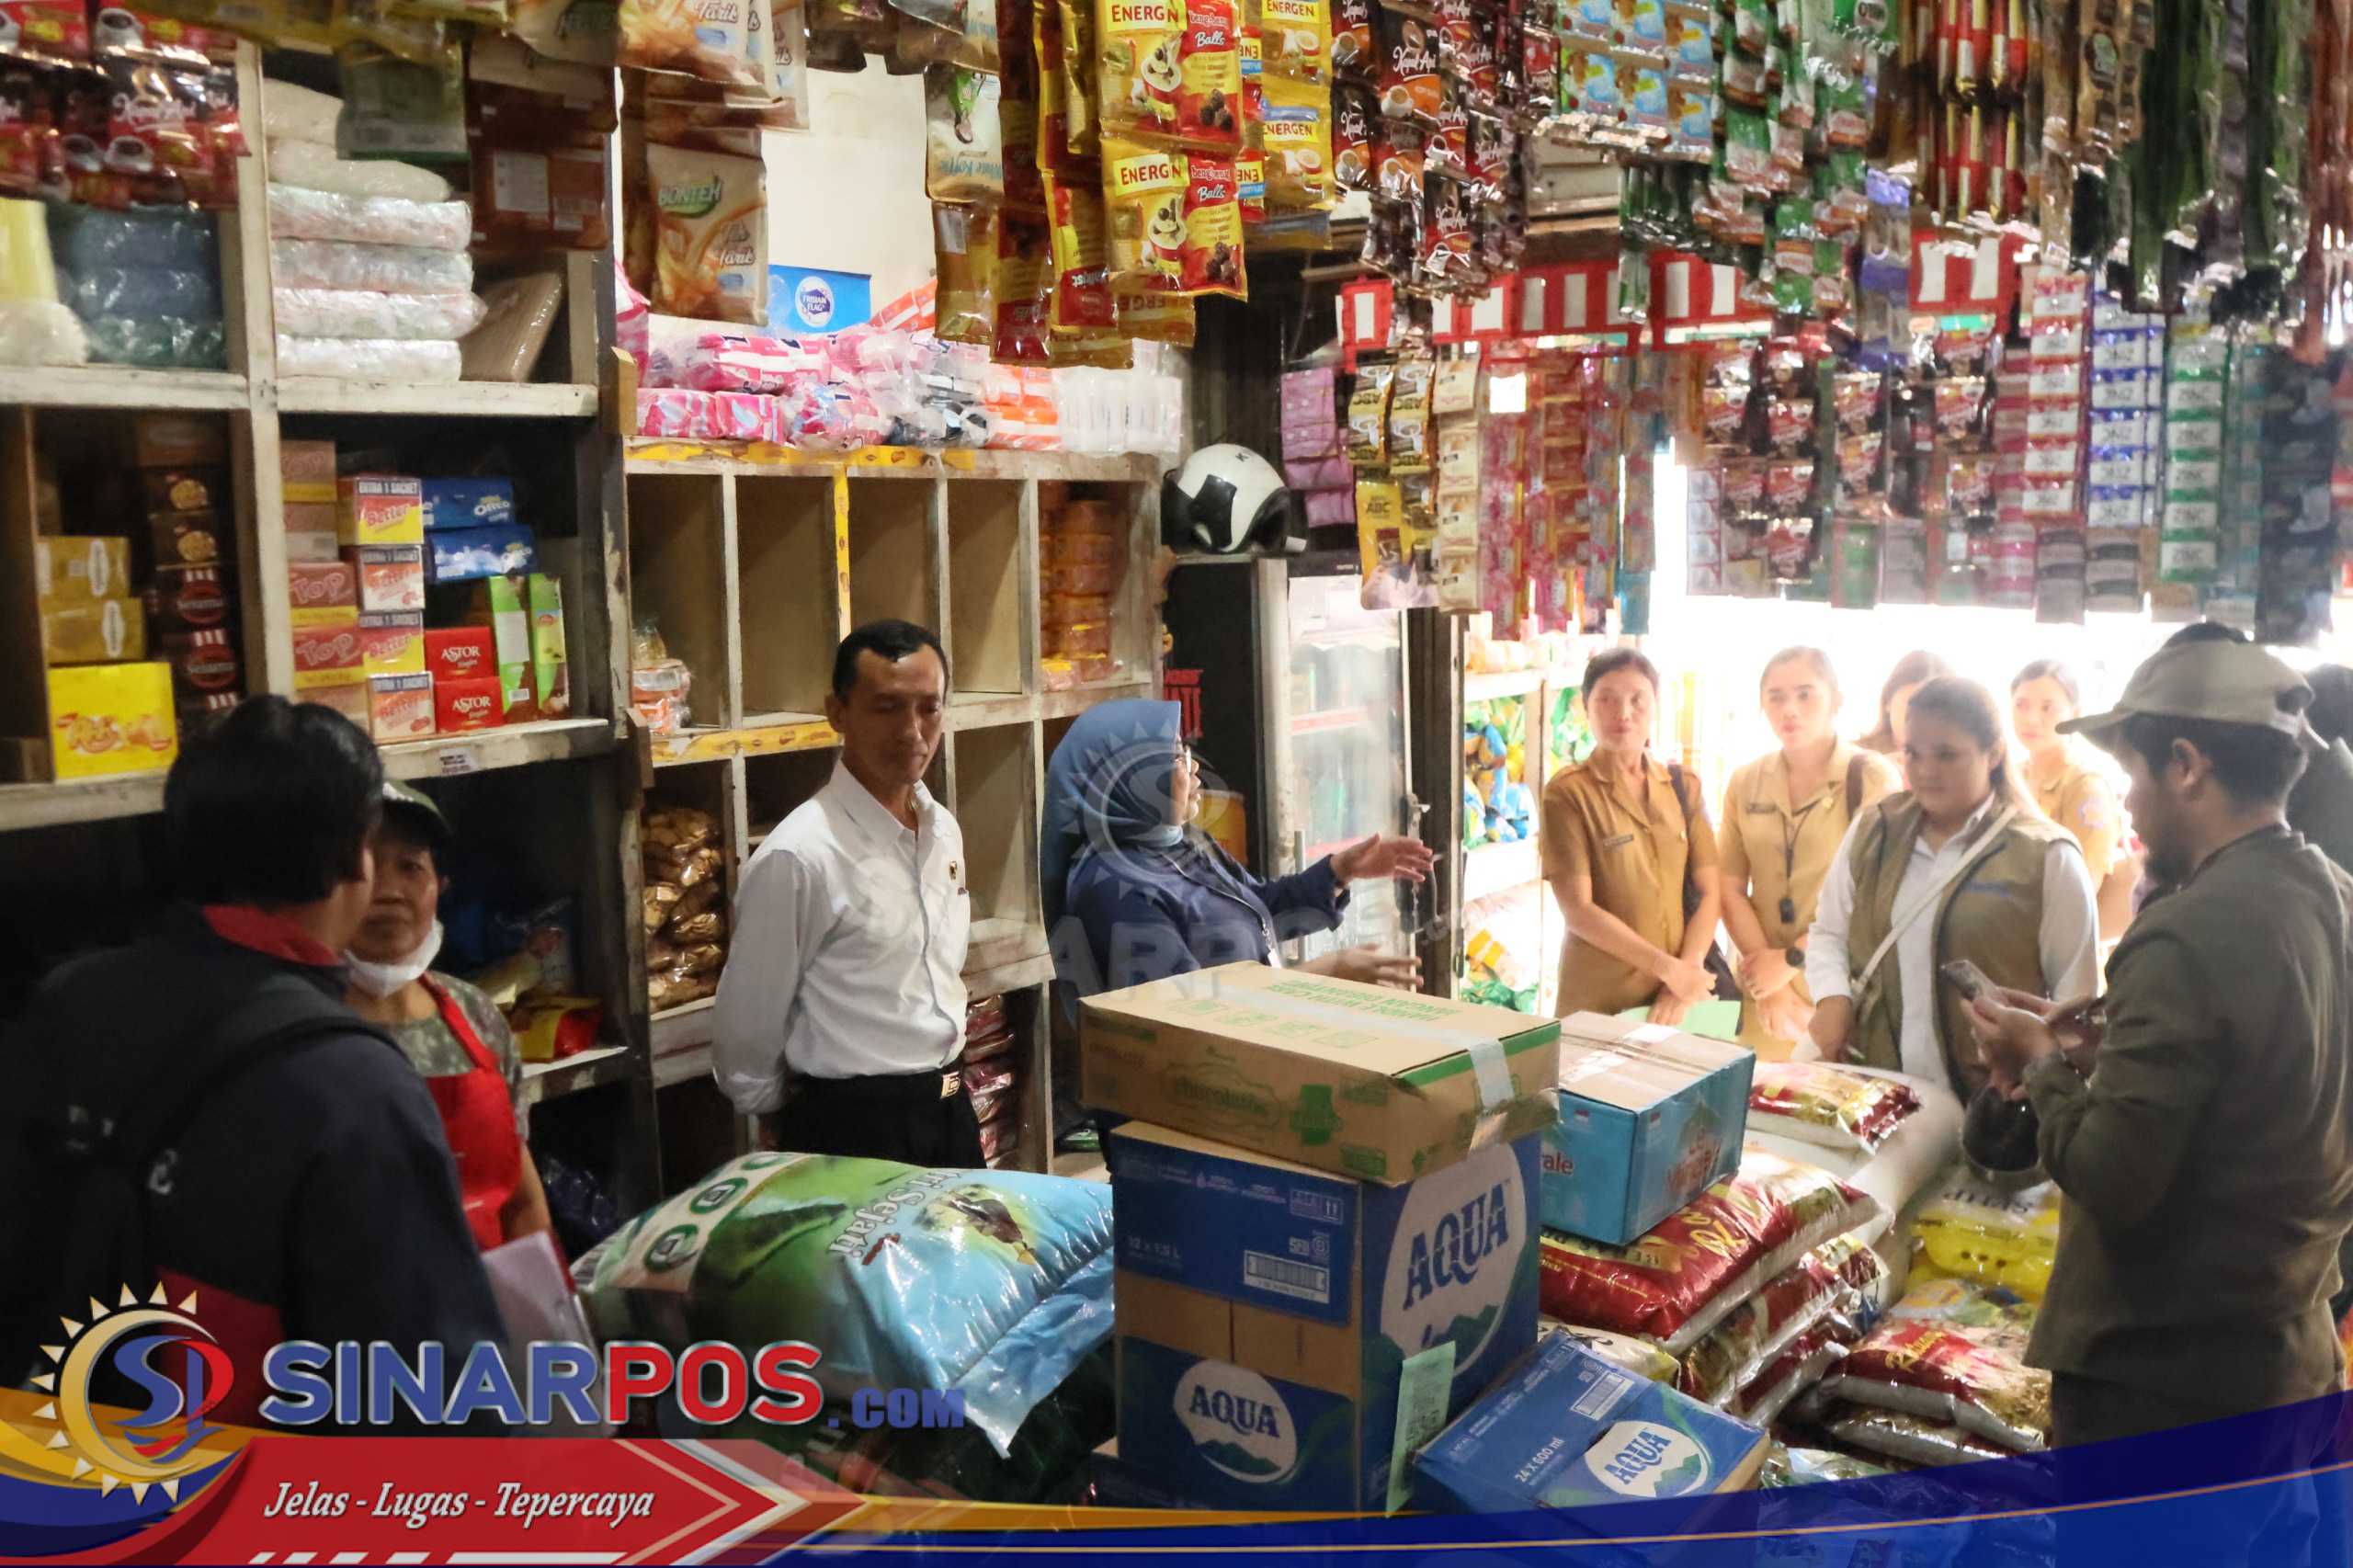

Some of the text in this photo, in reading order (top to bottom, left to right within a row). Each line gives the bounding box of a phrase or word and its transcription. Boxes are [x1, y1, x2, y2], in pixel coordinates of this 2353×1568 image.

[1110, 5, 1179, 23] ENERGN
[1120, 163, 1183, 186] ENERGN
[441, 646, 481, 663] ASTOR
[452, 696, 492, 712] ASTOR
[1403, 1183, 1509, 1311] AQUA
[1189, 1384, 1280, 1437] AQUA
[1604, 1427, 1672, 1485] AQUA
